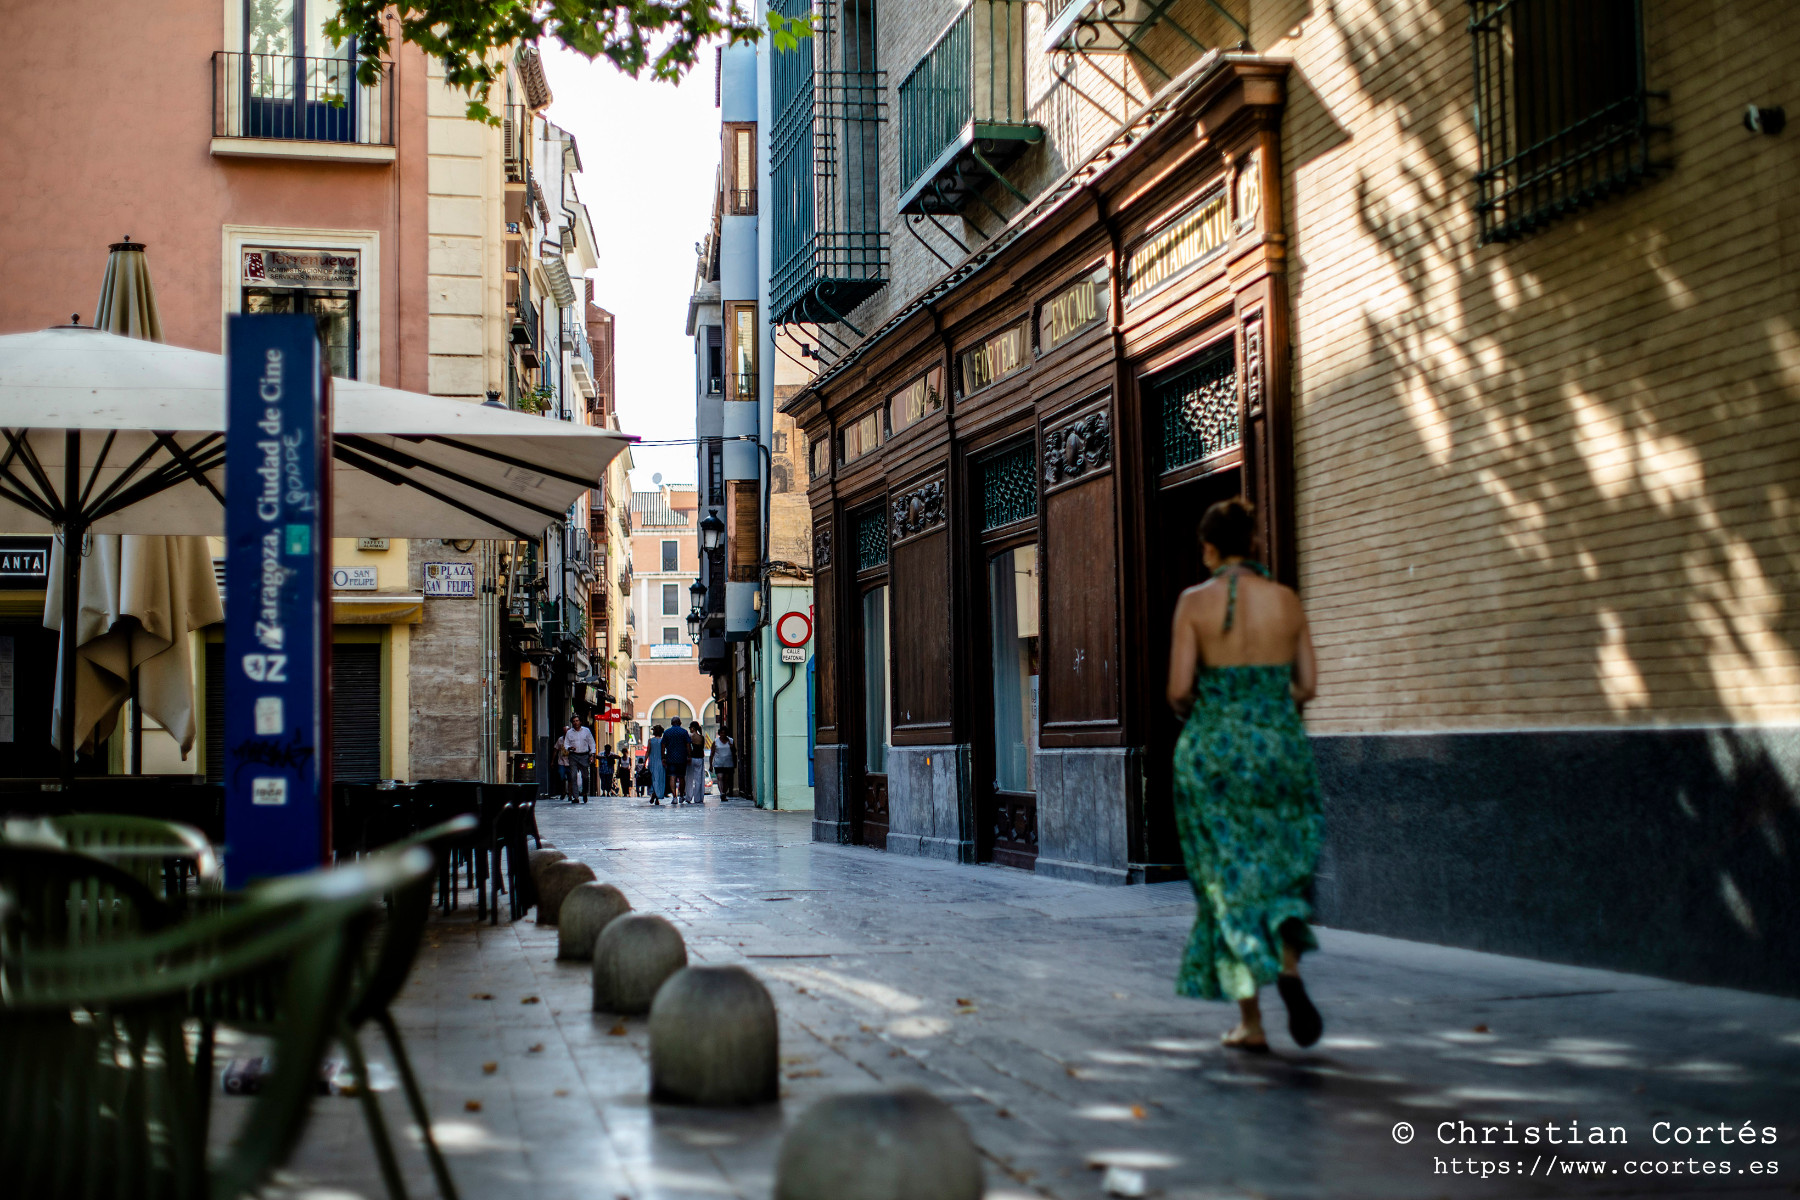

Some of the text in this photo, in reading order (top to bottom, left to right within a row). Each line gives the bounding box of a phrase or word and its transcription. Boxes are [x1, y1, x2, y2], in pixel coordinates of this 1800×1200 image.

[269, 251, 356, 267] Torrenueva
[974, 333, 1017, 387] FORTEA
[260, 349, 282, 401] Cine
[905, 382, 927, 422] CASA
[257, 408, 281, 435] de
[257, 441, 280, 521] Ciudad
[354, 570, 370, 578] SAN
[441, 565, 473, 576] PLAZA
[349, 578, 375, 586] FELIPE
[426, 580, 472, 592] SAN FELIPE
